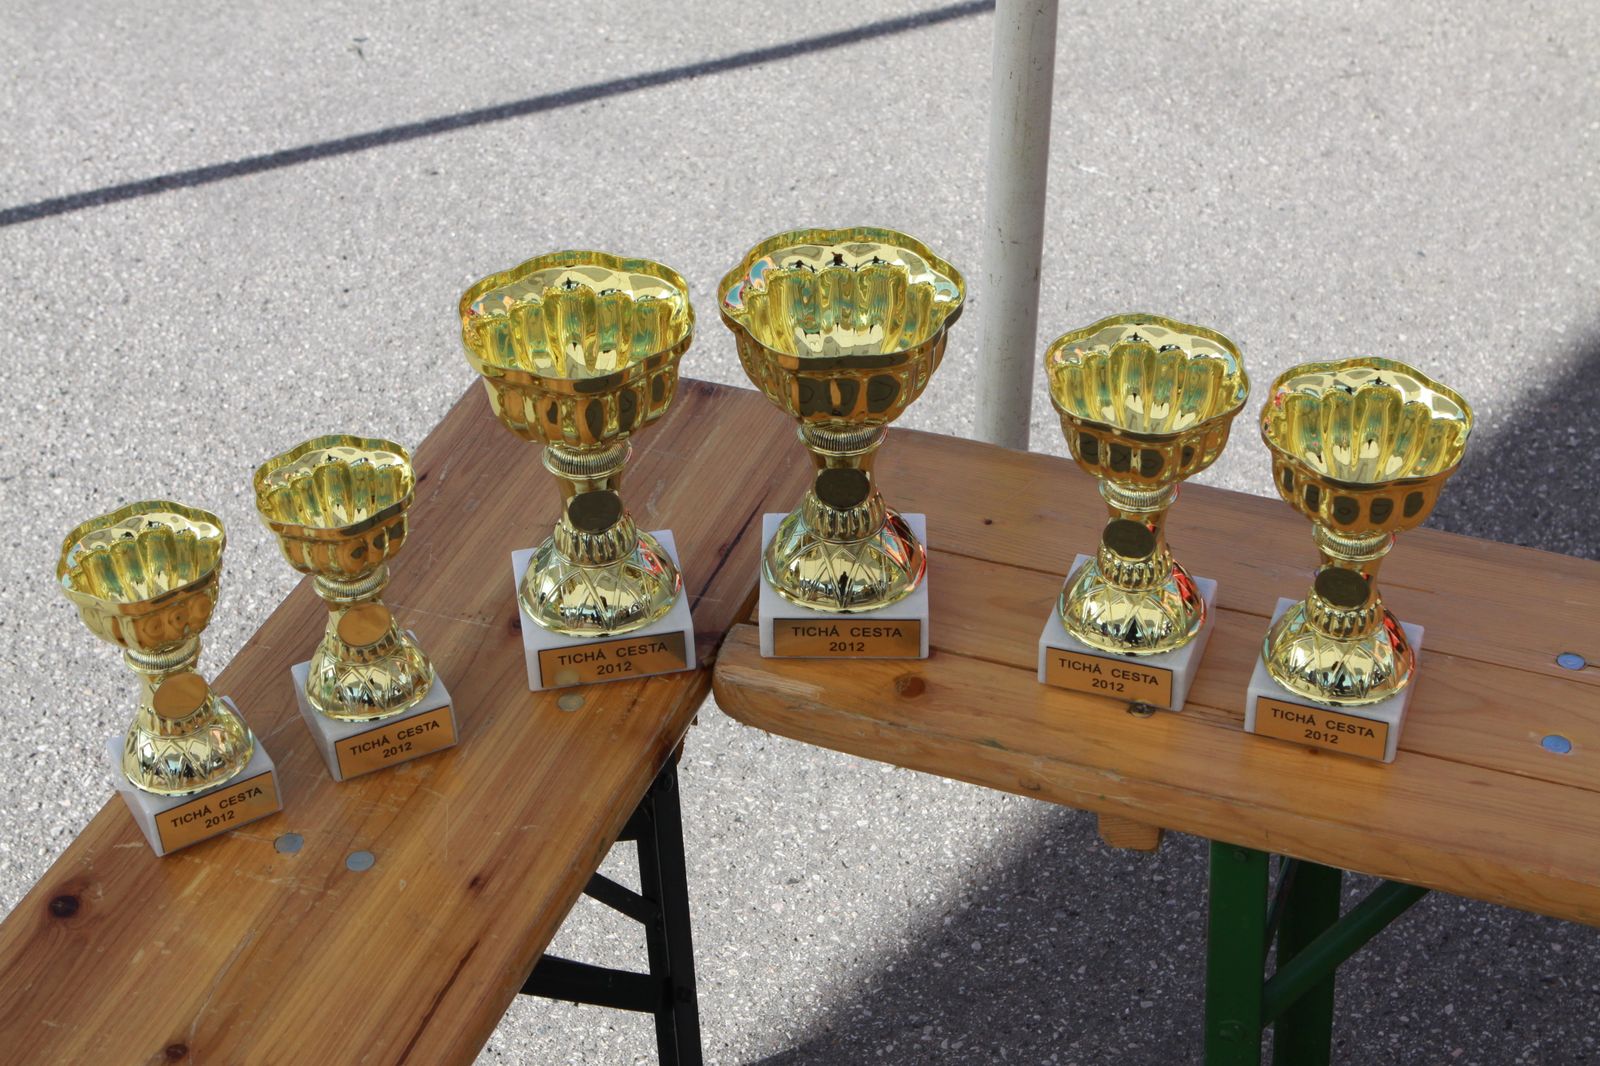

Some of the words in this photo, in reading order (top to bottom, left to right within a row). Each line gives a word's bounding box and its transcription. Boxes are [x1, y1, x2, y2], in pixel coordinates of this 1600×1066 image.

[792, 625, 840, 637] TICHÁ
[850, 627, 902, 637] CESTA
[558, 648, 606, 665] TICHÁ
[616, 643, 668, 658] CESTA
[829, 642, 864, 652] 2012
[597, 662, 632, 675] 2012
[1059, 658, 1102, 674] TICHÁ
[1112, 668, 1159, 685] CESTA
[1092, 678, 1124, 692] 2012
[1272, 708, 1316, 726] TICHÁ
[1326, 720, 1375, 737] CESTA
[350, 734, 390, 756] TICHÁ
[397, 720, 440, 741] CESTA
[1305, 729, 1338, 744] 2012
[383, 742, 413, 758] 2012
[171, 805, 212, 827] TICHÁ
[219, 787, 263, 809] CESTA
[205, 810, 235, 828] 2012
